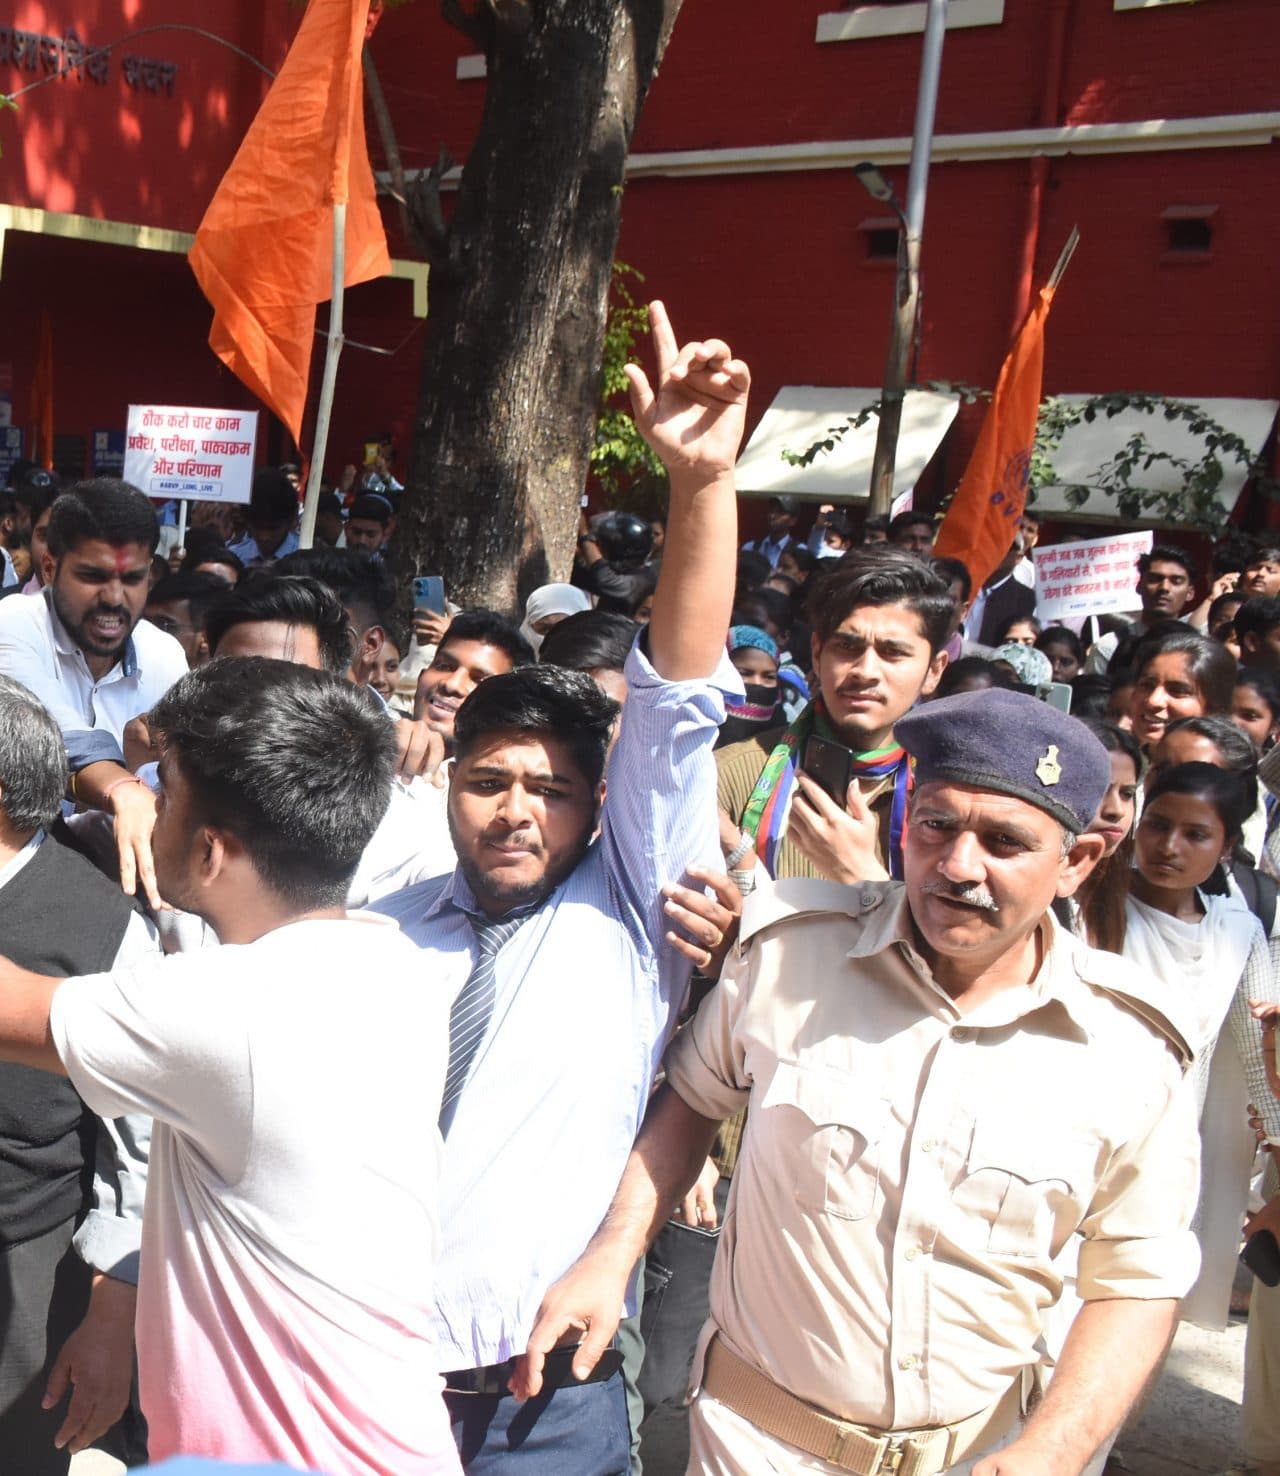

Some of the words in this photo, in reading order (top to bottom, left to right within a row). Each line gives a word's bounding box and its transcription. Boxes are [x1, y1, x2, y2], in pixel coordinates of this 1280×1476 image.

[143, 409, 163, 427] ठीक
[167, 411, 189, 428] करो
[193, 416, 212, 430] चार
[215, 417, 241, 431] काम
[160, 435, 198, 455] परीक्षा,
[153, 458, 174, 474] और
[177, 460, 223, 478] परिणाम
